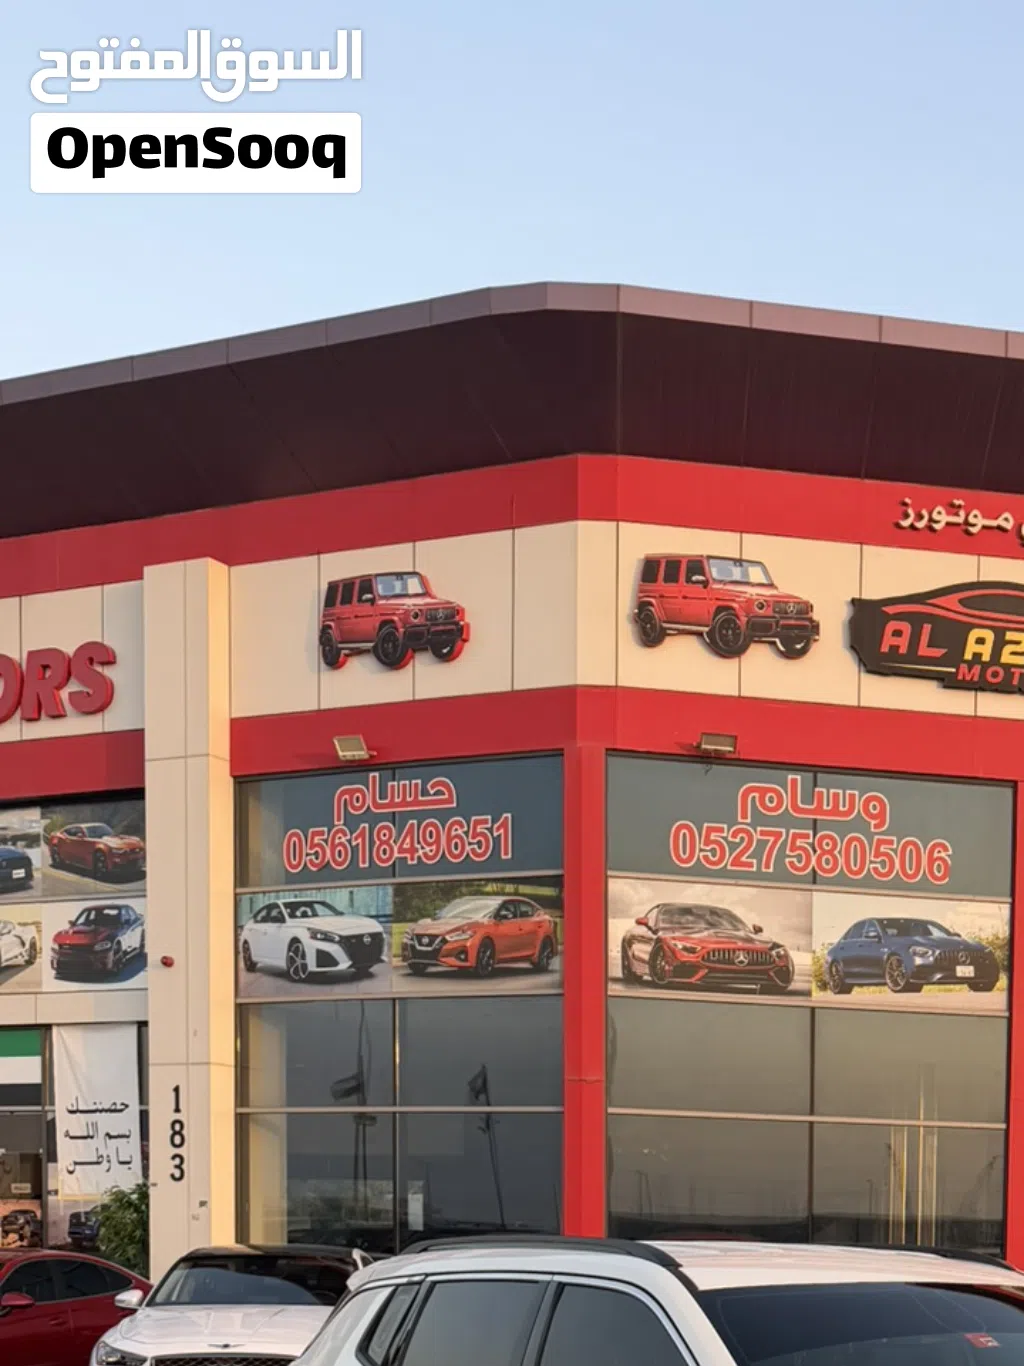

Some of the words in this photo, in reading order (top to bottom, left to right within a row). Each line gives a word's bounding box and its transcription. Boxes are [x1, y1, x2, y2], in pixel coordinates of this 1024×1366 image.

[895, 497, 1015, 536] موتورز
[880, 620, 948, 657] AL
[333, 772, 457, 826] حسام
[737, 775, 890, 832] وسام
[283, 813, 513, 873] 0561849651
[669, 821, 952, 884] 0527580506
[63, 1120, 99, 1141] الله
[103, 1128, 132, 1150] بسم
